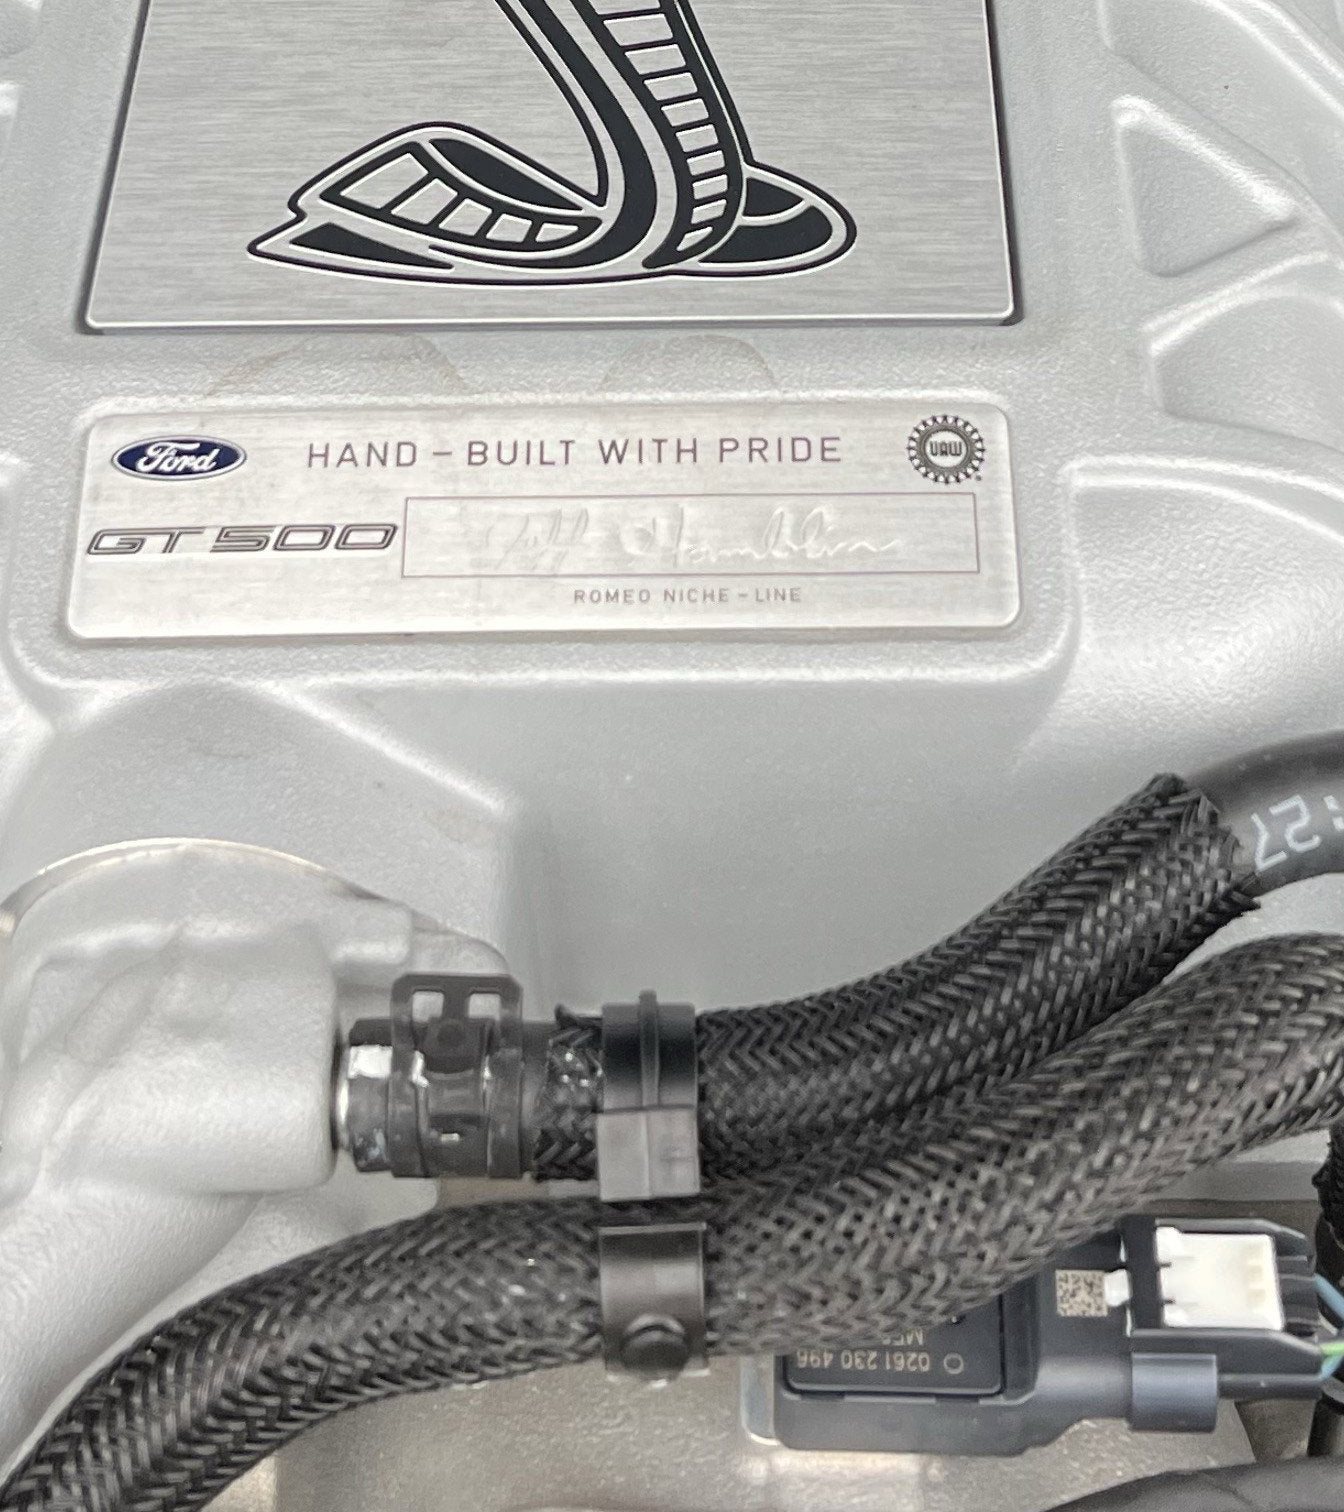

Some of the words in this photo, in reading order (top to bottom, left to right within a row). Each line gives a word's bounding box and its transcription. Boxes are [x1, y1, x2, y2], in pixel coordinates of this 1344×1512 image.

[307, 440, 418, 468] HAND
[467, 439, 575, 466] BUILT
[598, 437, 698, 465] WITH
[719, 436, 842, 464] PRIDE
[929, 440, 963, 457] UAW
[574, 588, 651, 604] ROMEO
[663, 587, 729, 604] NICHE
[756, 587, 802, 603] LINE
